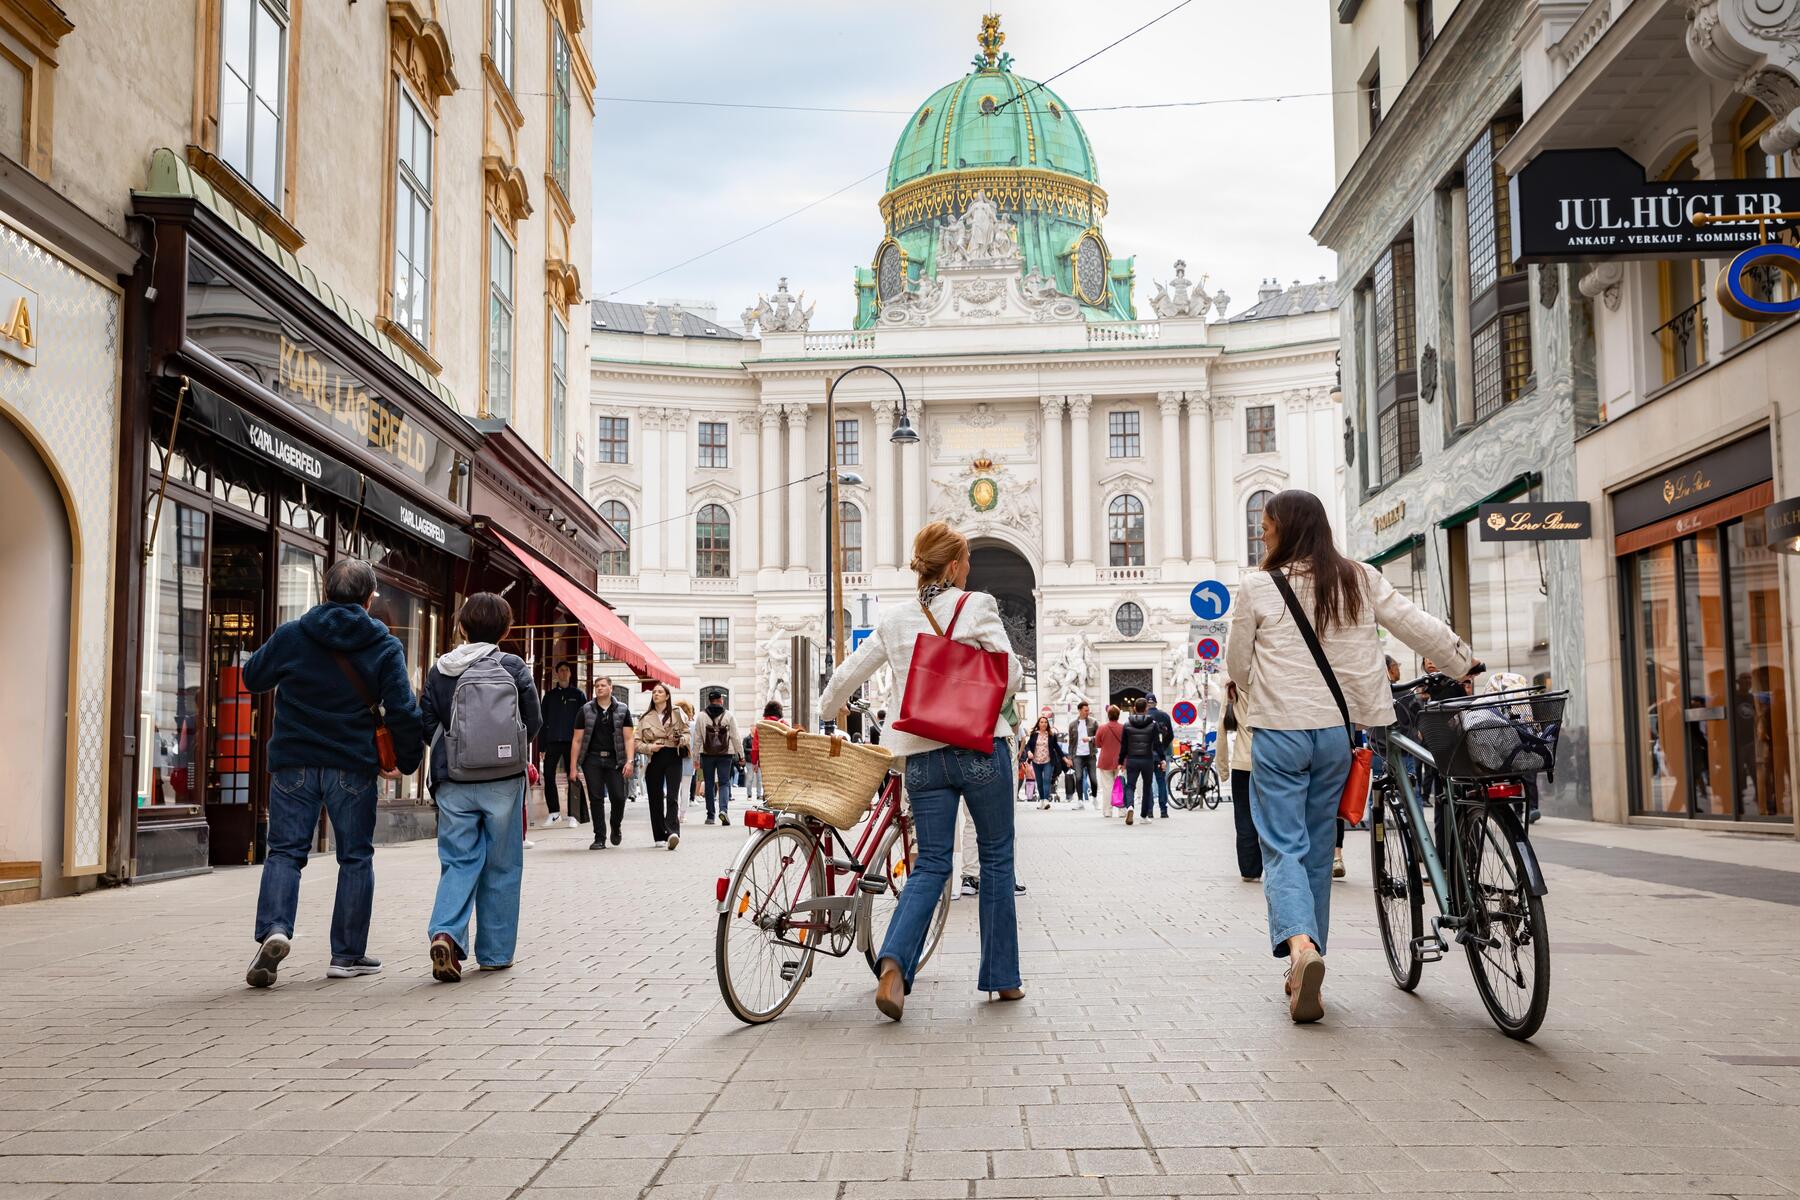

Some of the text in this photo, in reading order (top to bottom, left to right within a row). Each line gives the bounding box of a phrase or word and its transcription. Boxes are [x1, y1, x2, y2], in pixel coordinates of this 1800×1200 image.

[1568, 231, 1776, 246] ANKAUF VERKAUF KOMMISSIN
[280, 335, 426, 473] KARL LAGERFELD
[250, 424, 322, 479] KARL LAGERFELD
[400, 505, 446, 544] KARL LAGERFELD
[1505, 510, 1582, 531] Loro Piana
